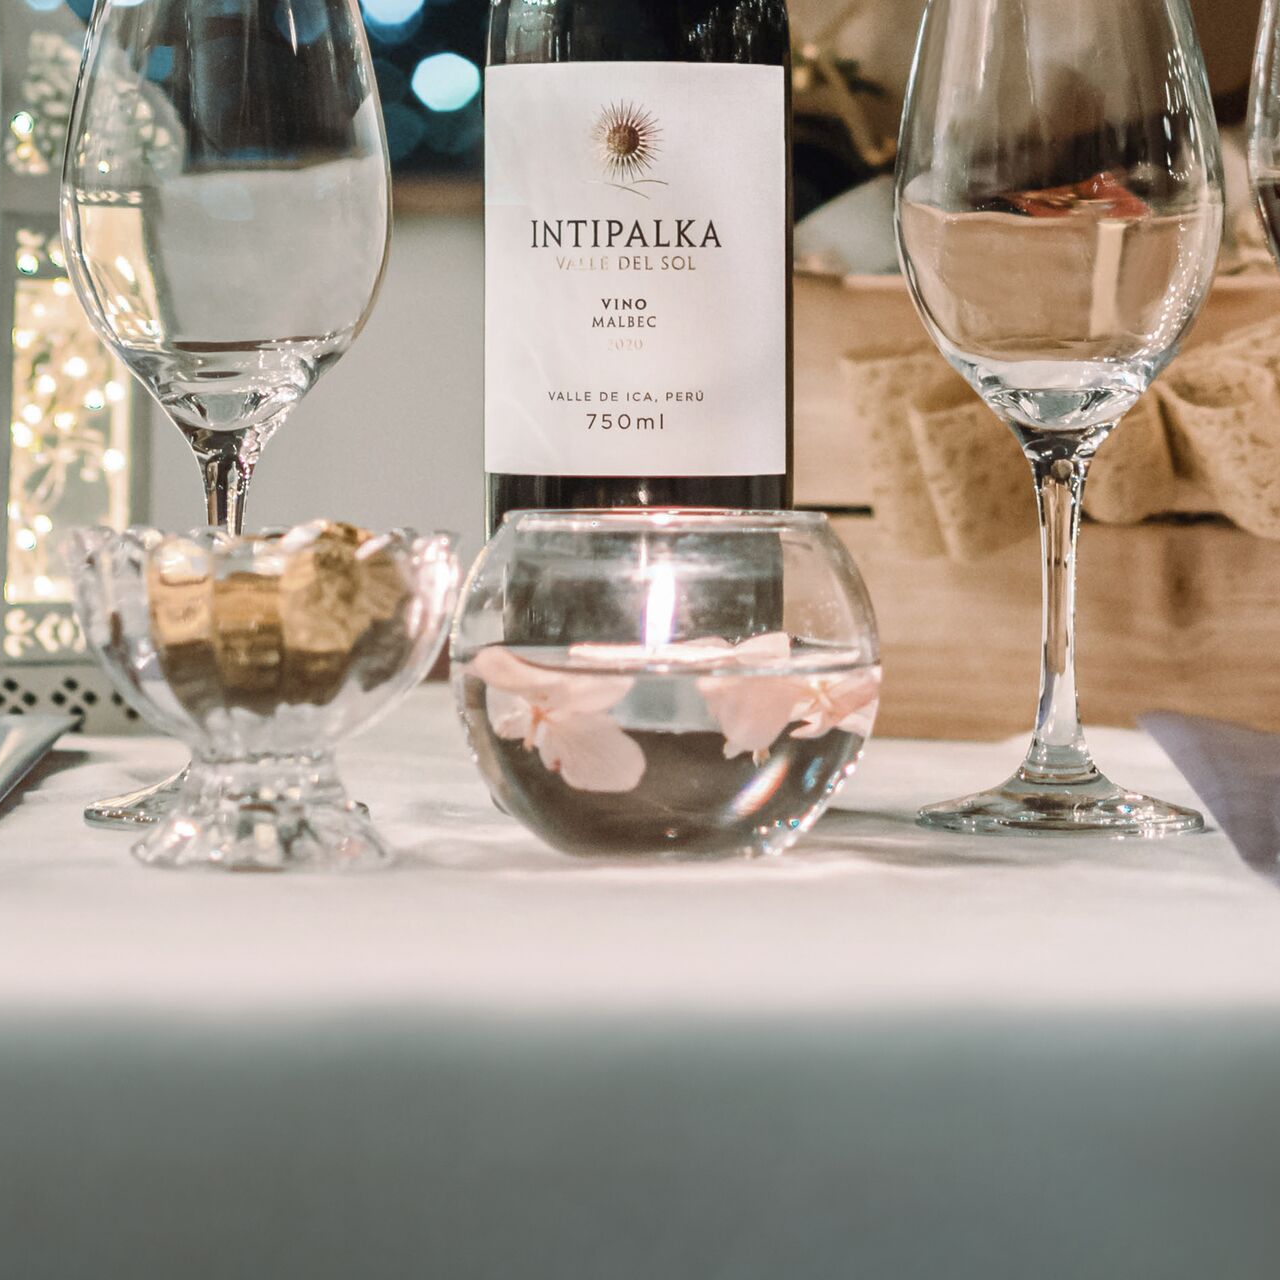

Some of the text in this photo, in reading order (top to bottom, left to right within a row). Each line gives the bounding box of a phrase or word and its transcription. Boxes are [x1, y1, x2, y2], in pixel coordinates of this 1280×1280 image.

[531, 219, 722, 248] INTIPALKA
[618, 256, 653, 271] DEL
[661, 256, 696, 271] SOL
[601, 298, 647, 310] VINO
[592, 316, 656, 328] MALBEC
[548, 389, 704, 403] VALLE DE ICA, PERÚ
[586, 413, 664, 430] 750ml
